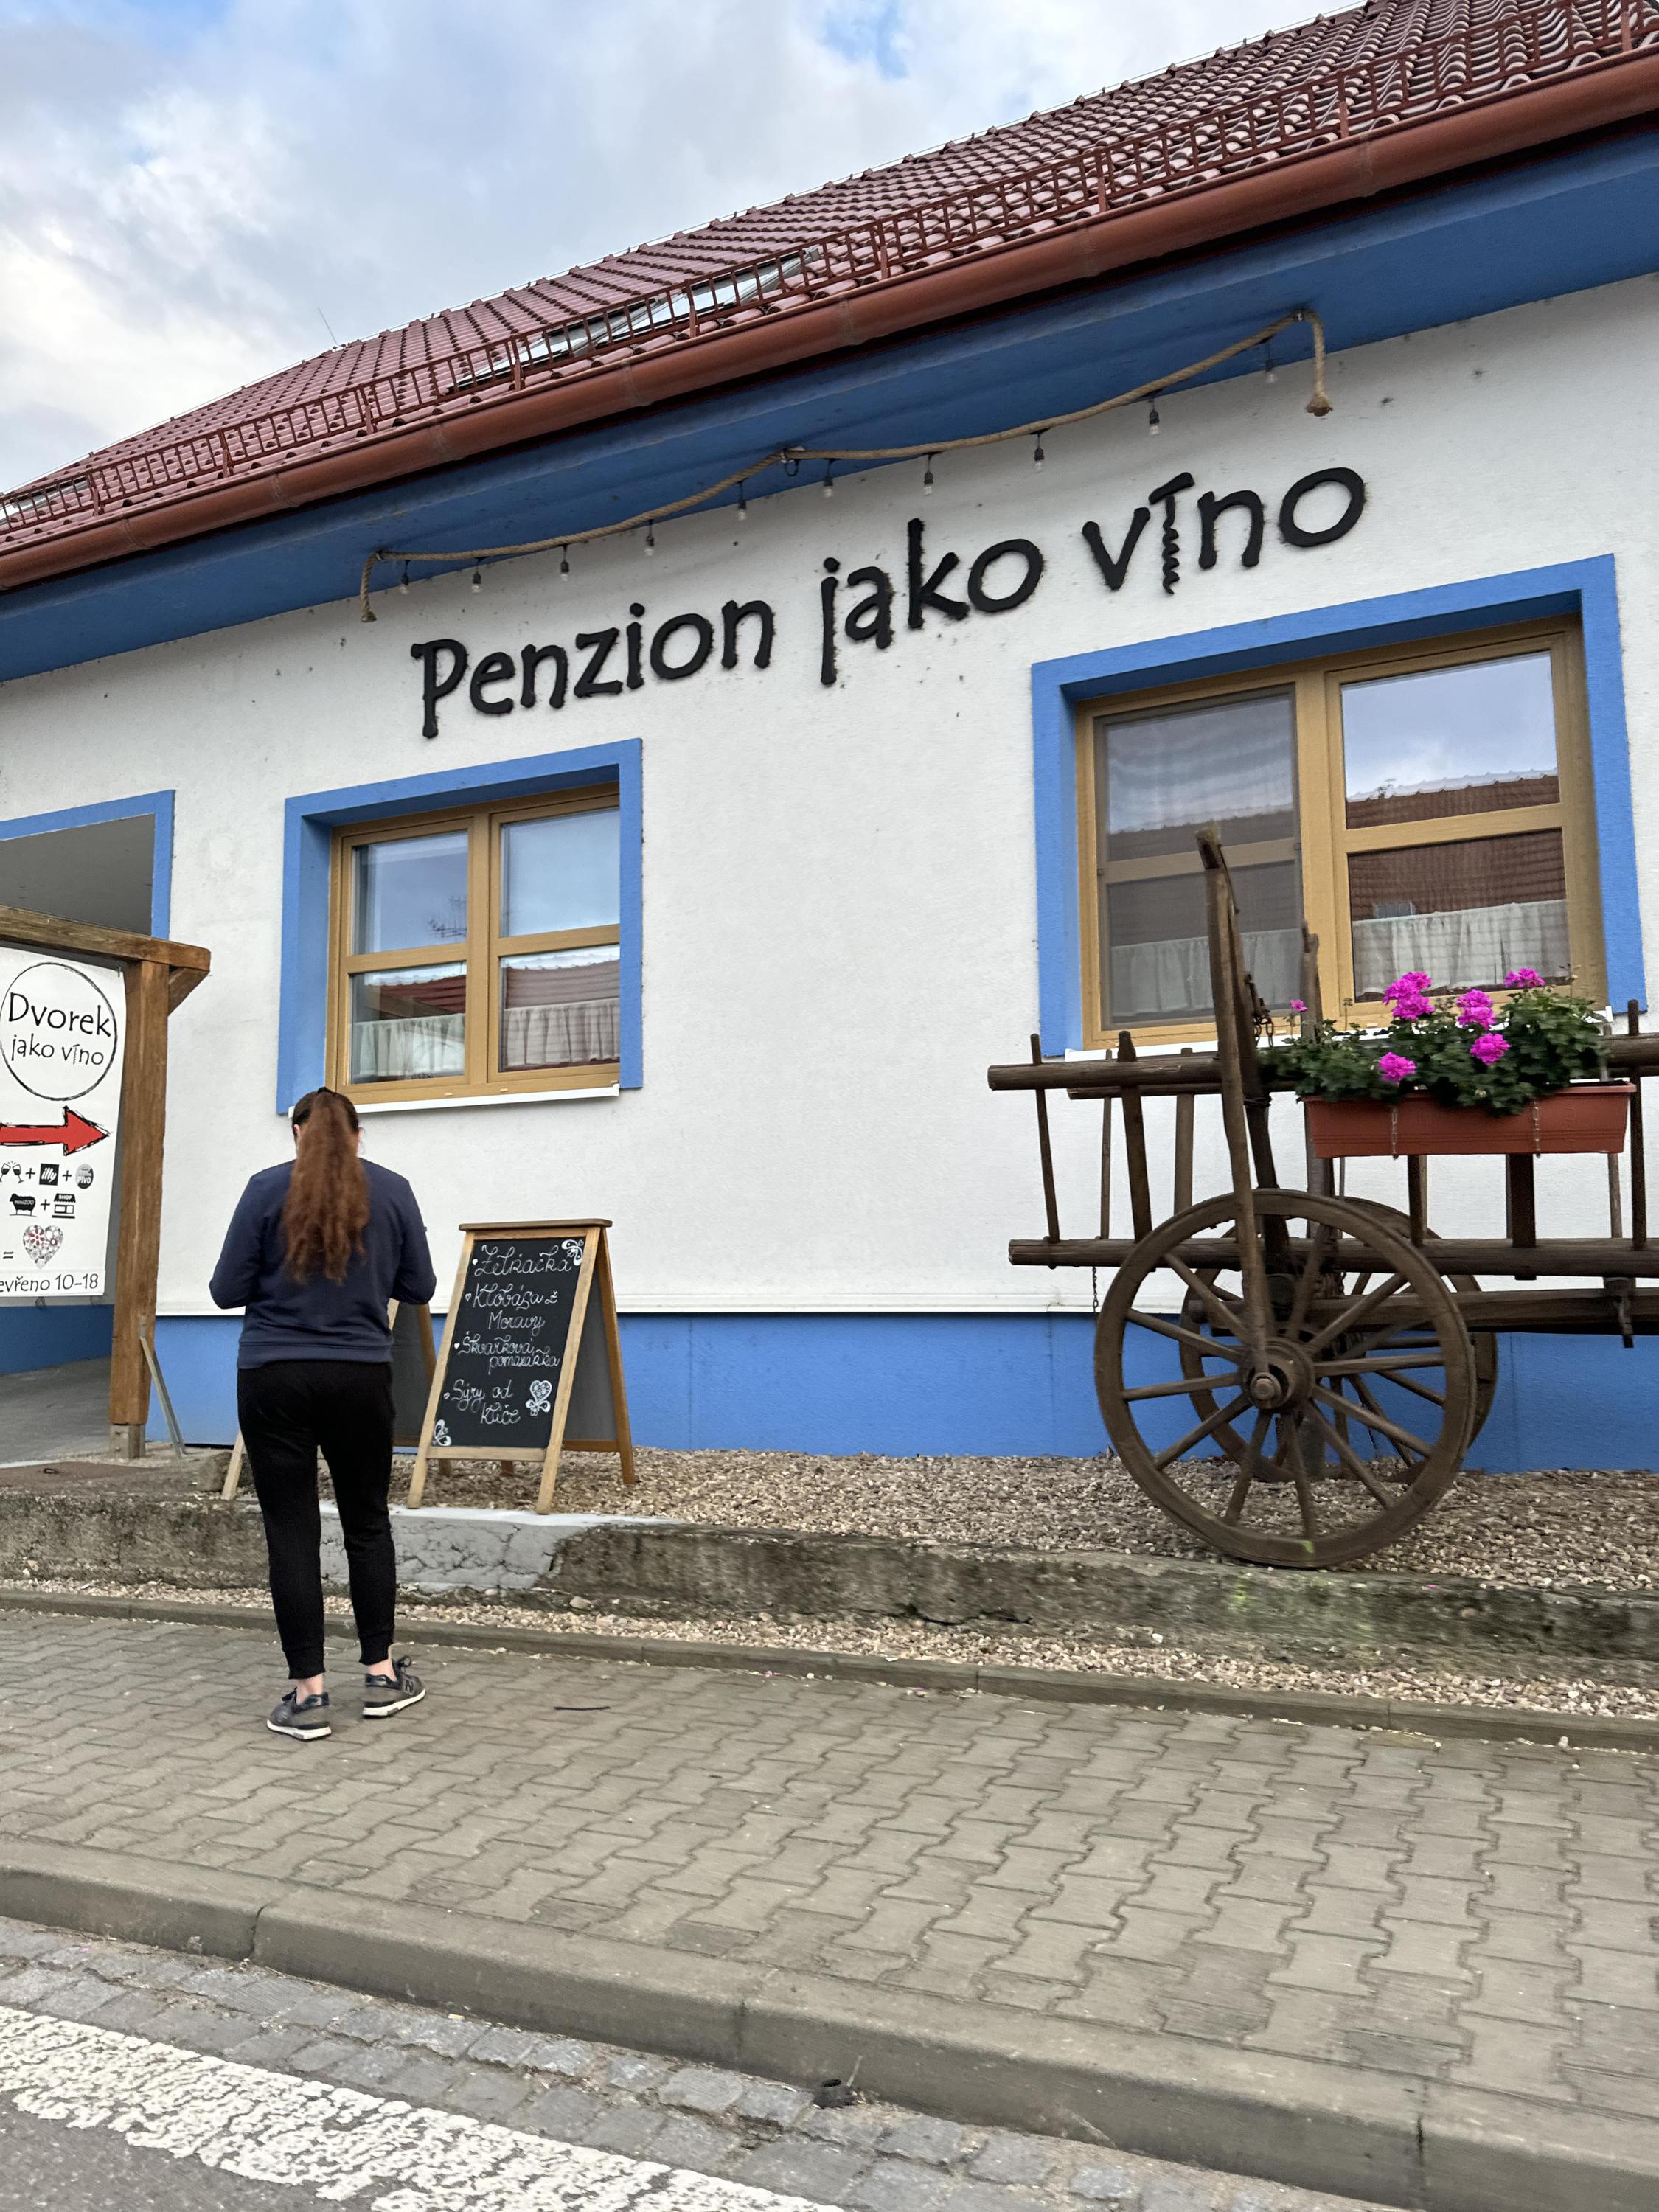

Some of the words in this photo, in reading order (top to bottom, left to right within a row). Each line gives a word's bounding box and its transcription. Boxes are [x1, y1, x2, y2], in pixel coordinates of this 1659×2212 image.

[409, 599, 776, 740] Penzion
[819, 518, 1045, 688] jako
[1081, 467, 1368, 595] víno
[8, 992, 111, 1037] Dvorek
[11, 1033, 55, 1062] jako
[61, 1043, 104, 1065] víno
[41, 1166, 58, 1183] illy
[77, 1176, 91, 1184] PIVO
[55, 1273, 99, 1290] 10-18
[488, 1310, 546, 1337] Moravy
[451, 1379, 486, 1413] Sýry
[492, 1379, 514, 1399] od
